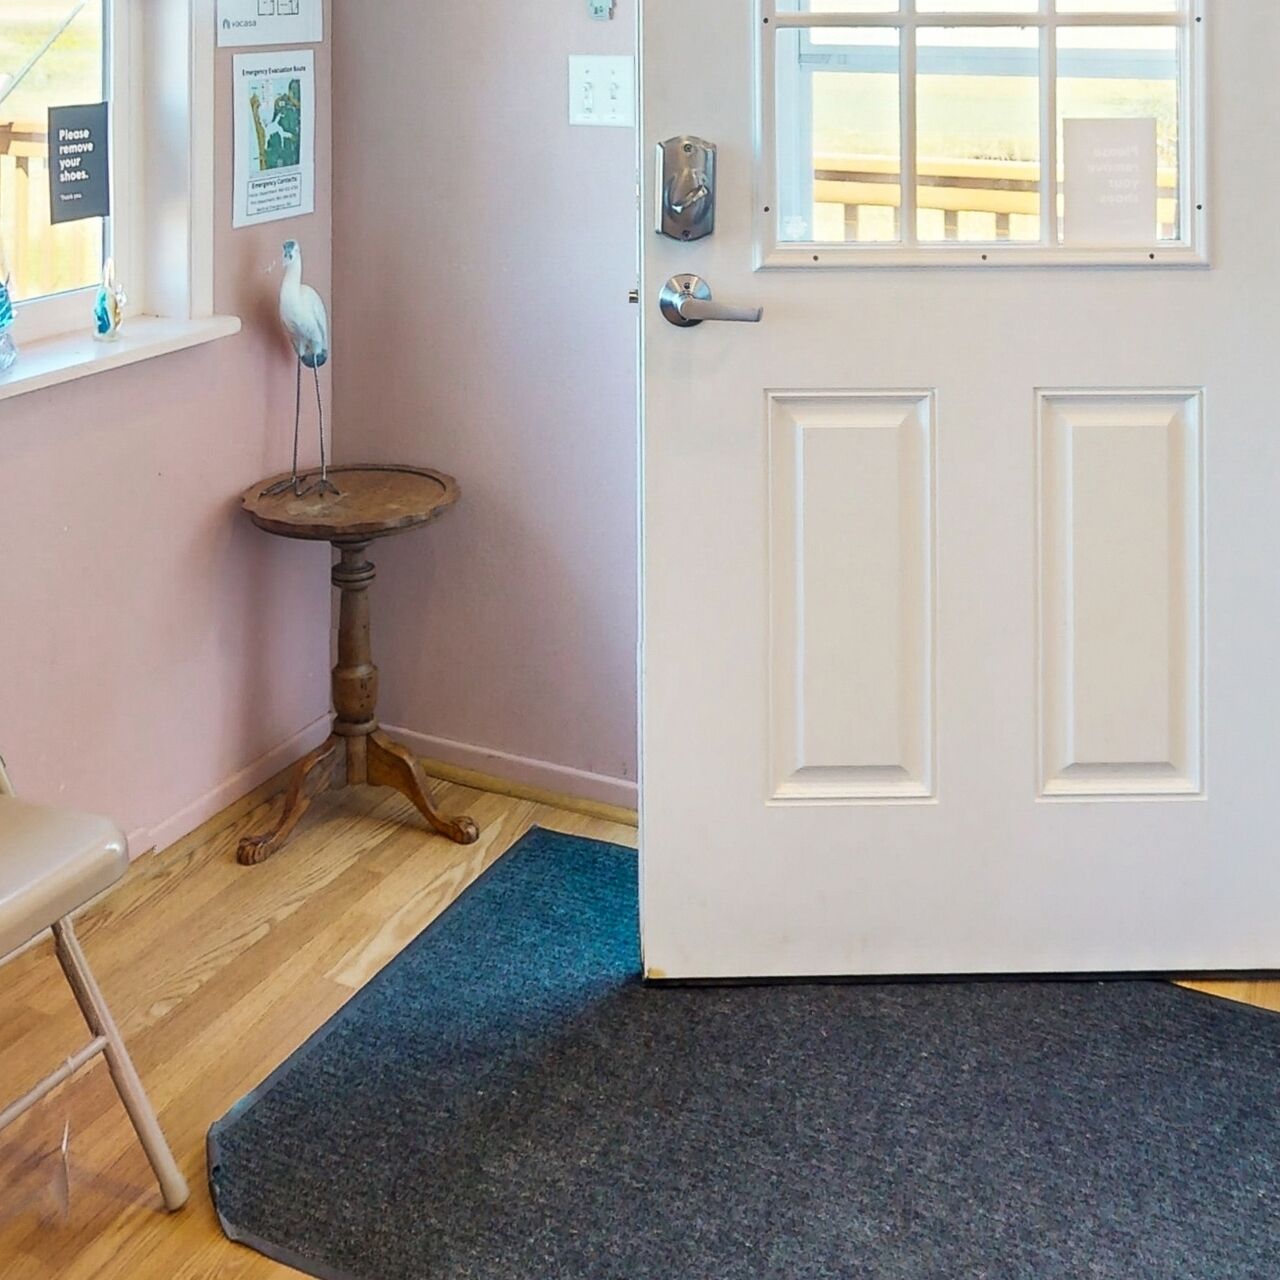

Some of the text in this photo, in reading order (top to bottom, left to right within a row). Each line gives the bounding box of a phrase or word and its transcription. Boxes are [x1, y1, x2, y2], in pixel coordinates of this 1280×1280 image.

[59, 129, 90, 141] Please
[59, 142, 94, 155] remove
[59, 157, 81, 171] your
[60, 170, 89, 182] shoes.
